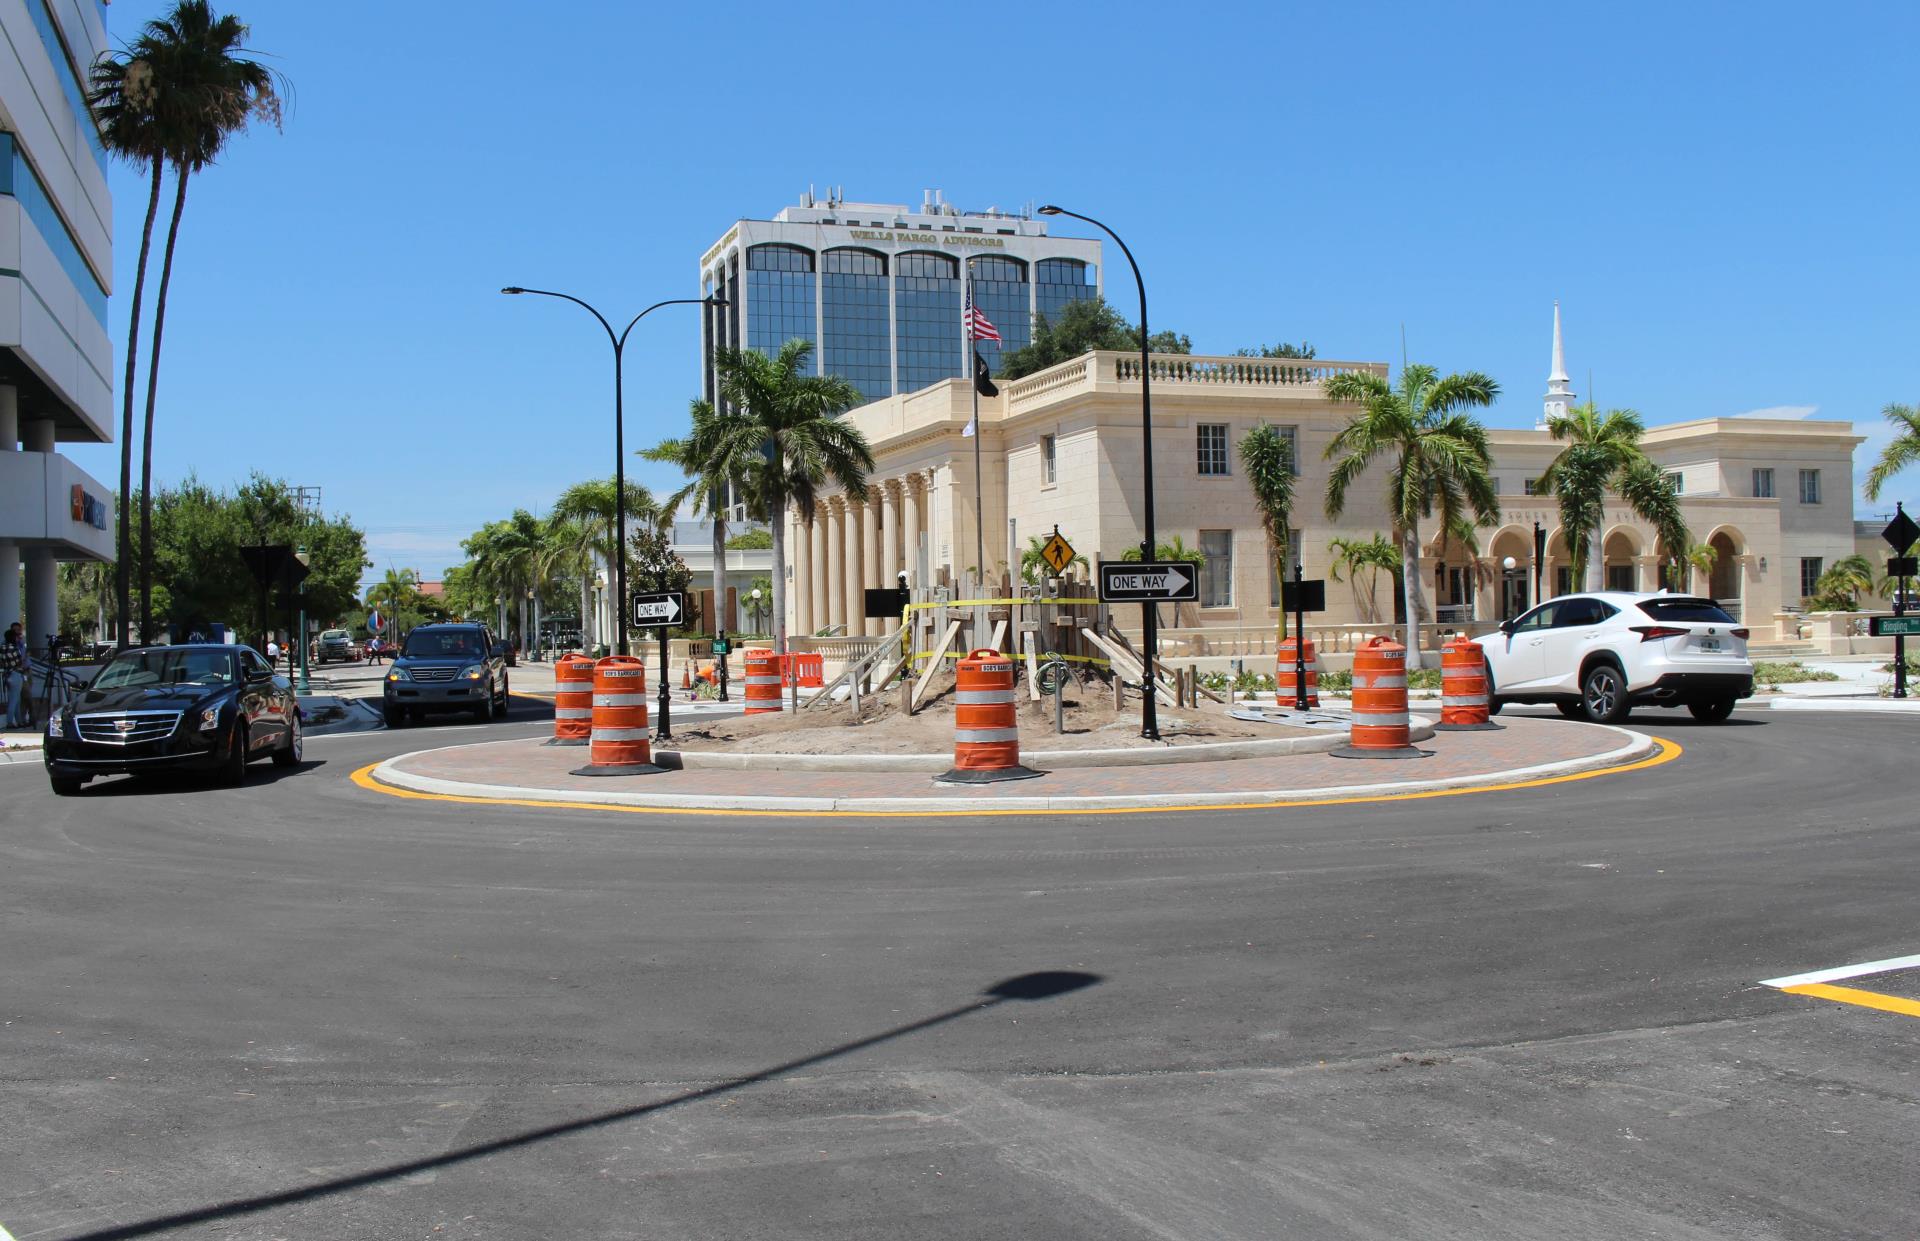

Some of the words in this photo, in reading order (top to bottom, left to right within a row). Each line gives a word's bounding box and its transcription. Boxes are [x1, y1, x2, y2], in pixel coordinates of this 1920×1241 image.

[849, 231, 893, 240] WELLS
[897, 233, 937, 243] FARGO
[943, 236, 1004, 247] ADVISORS
[1113, 576, 1138, 589] ONE
[1142, 575, 1167, 589] WAY
[640, 604, 653, 616] ONE
[654, 603, 668, 615] WAY
